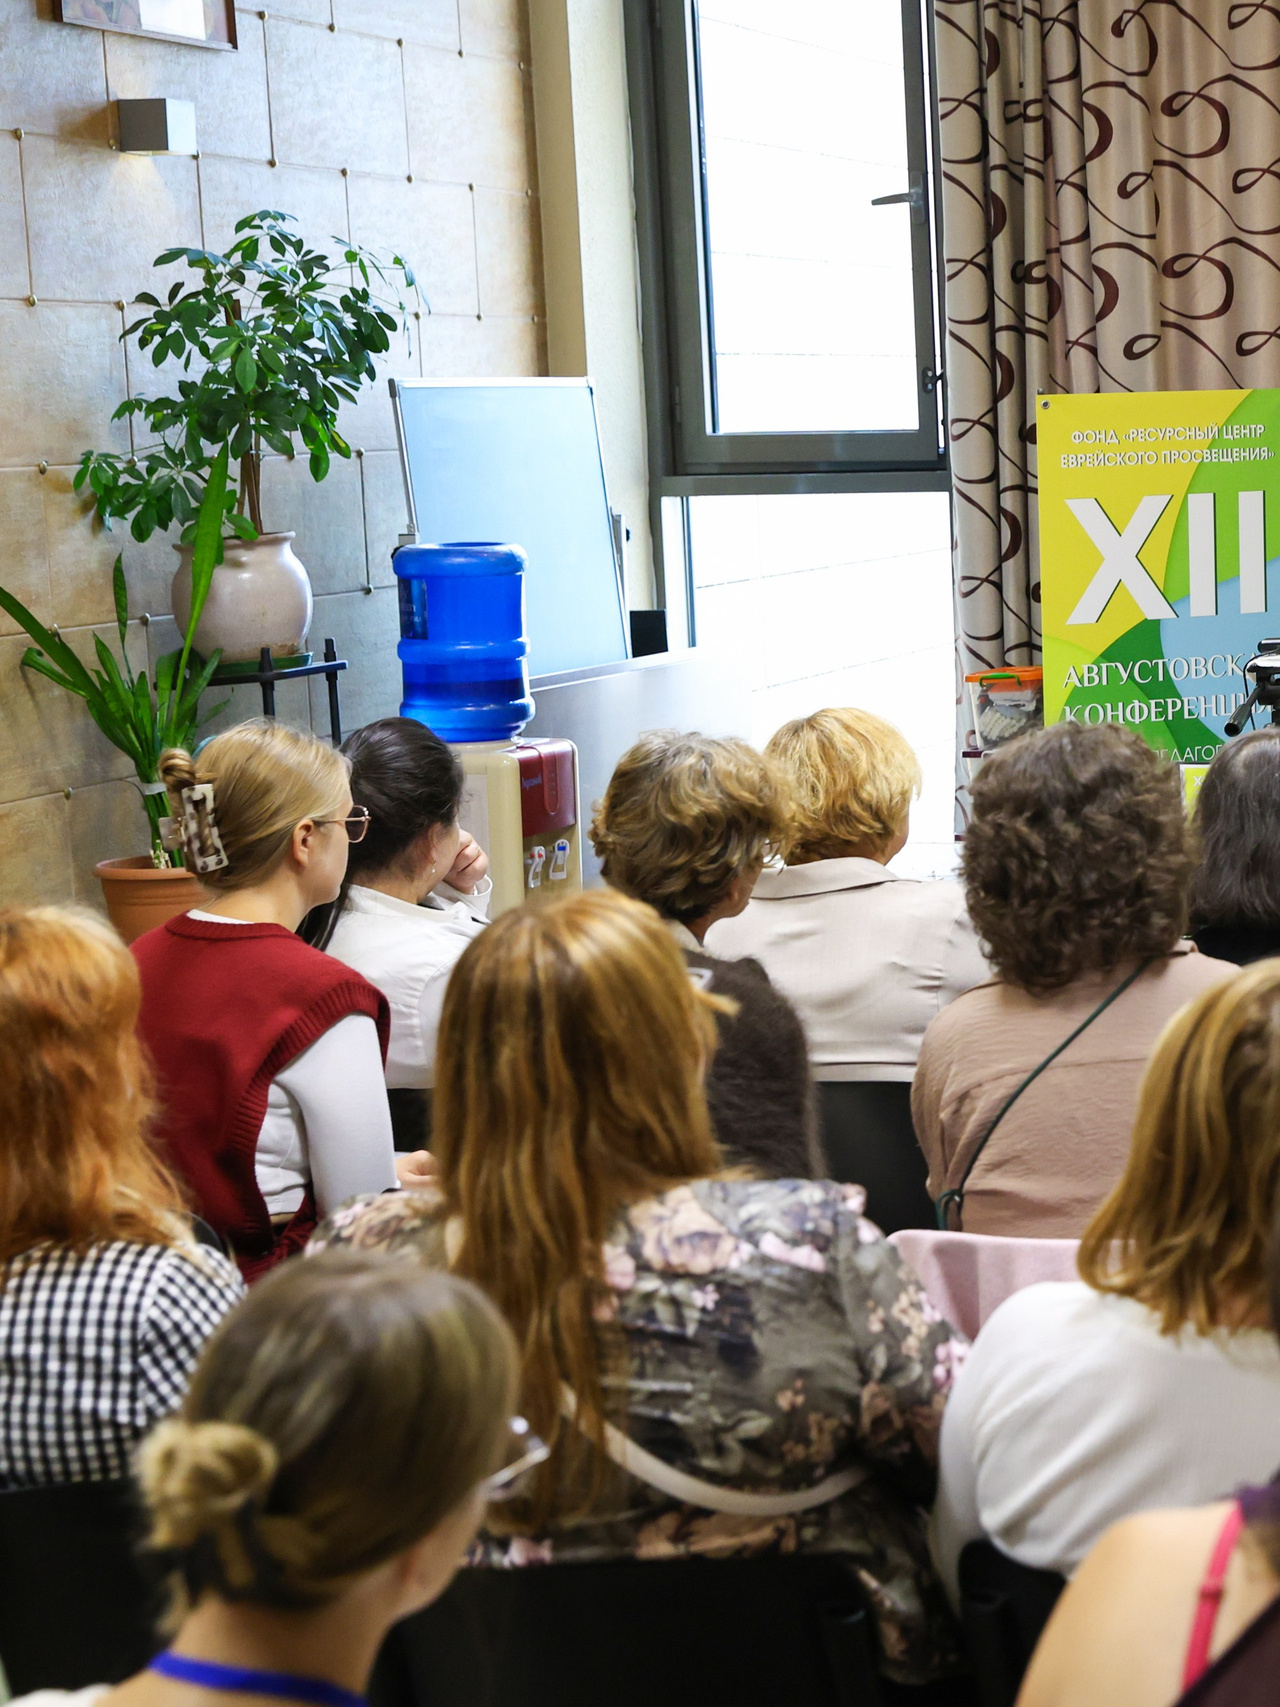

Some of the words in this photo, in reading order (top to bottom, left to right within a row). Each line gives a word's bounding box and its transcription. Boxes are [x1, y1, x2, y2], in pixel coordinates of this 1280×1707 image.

[1071, 430, 1120, 445] ФОНД
[1123, 423, 1219, 441] «РЕСУРСНЫЙ
[1223, 425, 1265, 440] ЦЕНТР
[1061, 450, 1158, 468] ЕВРЕЙСКОГО
[1162, 447, 1275, 465] ПРОСВЕЩЕНИЯ»
[1064, 490, 1267, 626] XII
[1063, 652, 1254, 688] АВГУСТОВСК
